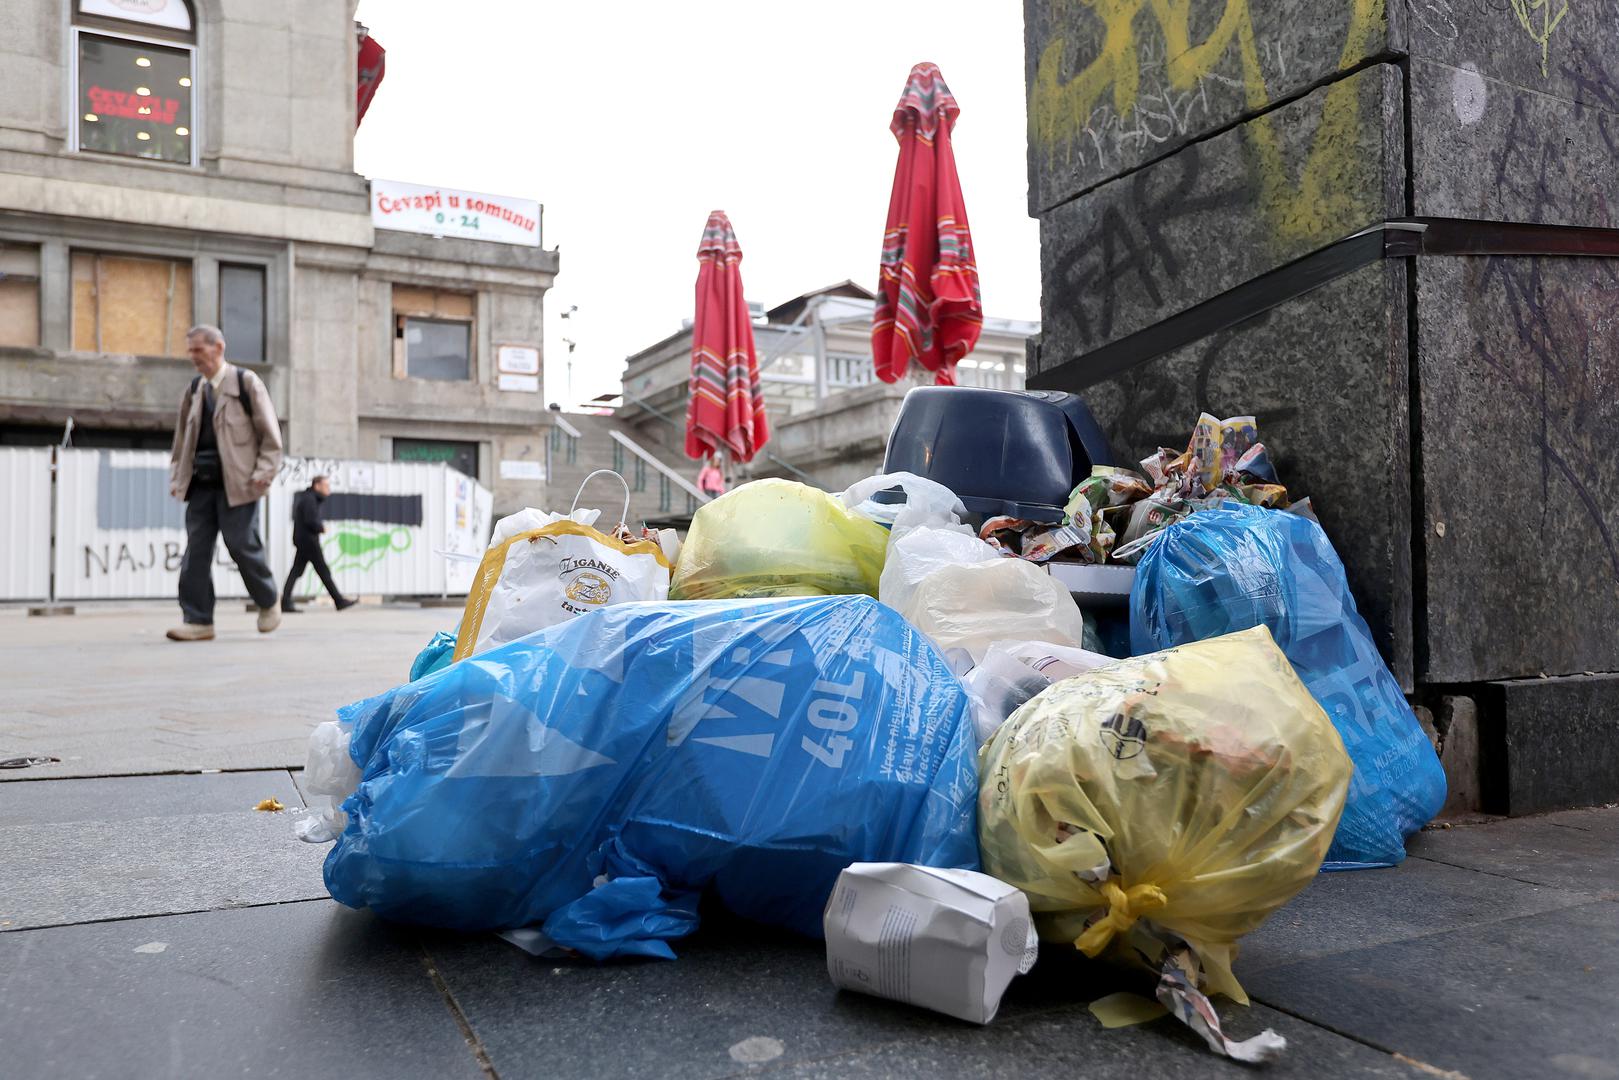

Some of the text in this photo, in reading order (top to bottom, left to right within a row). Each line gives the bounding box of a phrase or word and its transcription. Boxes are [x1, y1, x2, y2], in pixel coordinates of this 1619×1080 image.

[377, 190, 536, 233] Čevapi u somunu
[461, 215, 480, 230] 24
[798, 664, 866, 770] 40L
[886, 709, 901, 736] nisu
[880, 739, 896, 774] Vreće
[935, 735, 948, 752] od
[914, 747, 931, 785] Vreće
